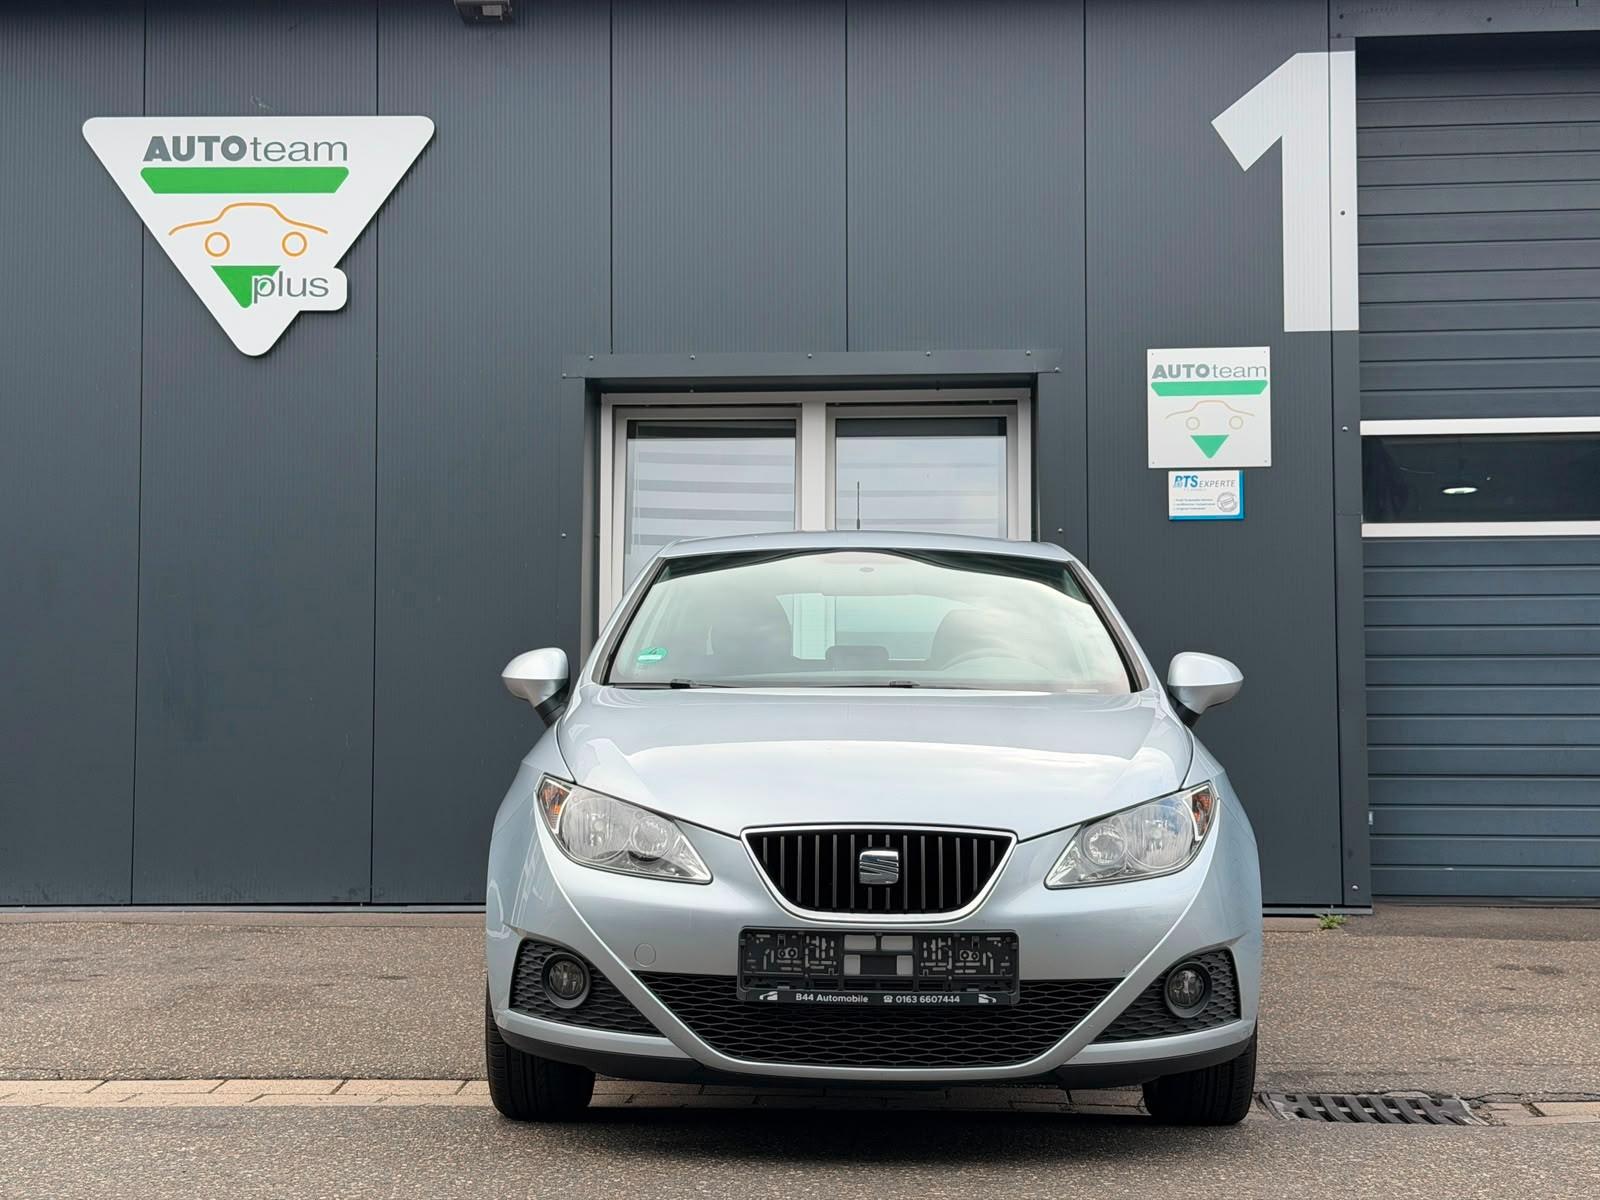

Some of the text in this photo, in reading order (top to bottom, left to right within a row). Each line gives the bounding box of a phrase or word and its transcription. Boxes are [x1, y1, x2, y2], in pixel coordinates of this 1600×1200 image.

[143, 135, 348, 162] AUTOteam
[1211, 50, 1359, 332] 1
[252, 271, 329, 304] plus
[1152, 364, 1267, 378] AUTOteam
[1199, 480, 1236, 488] EXPERTE
[795, 992, 960, 1004] B44 Automobile 0163 6607444
